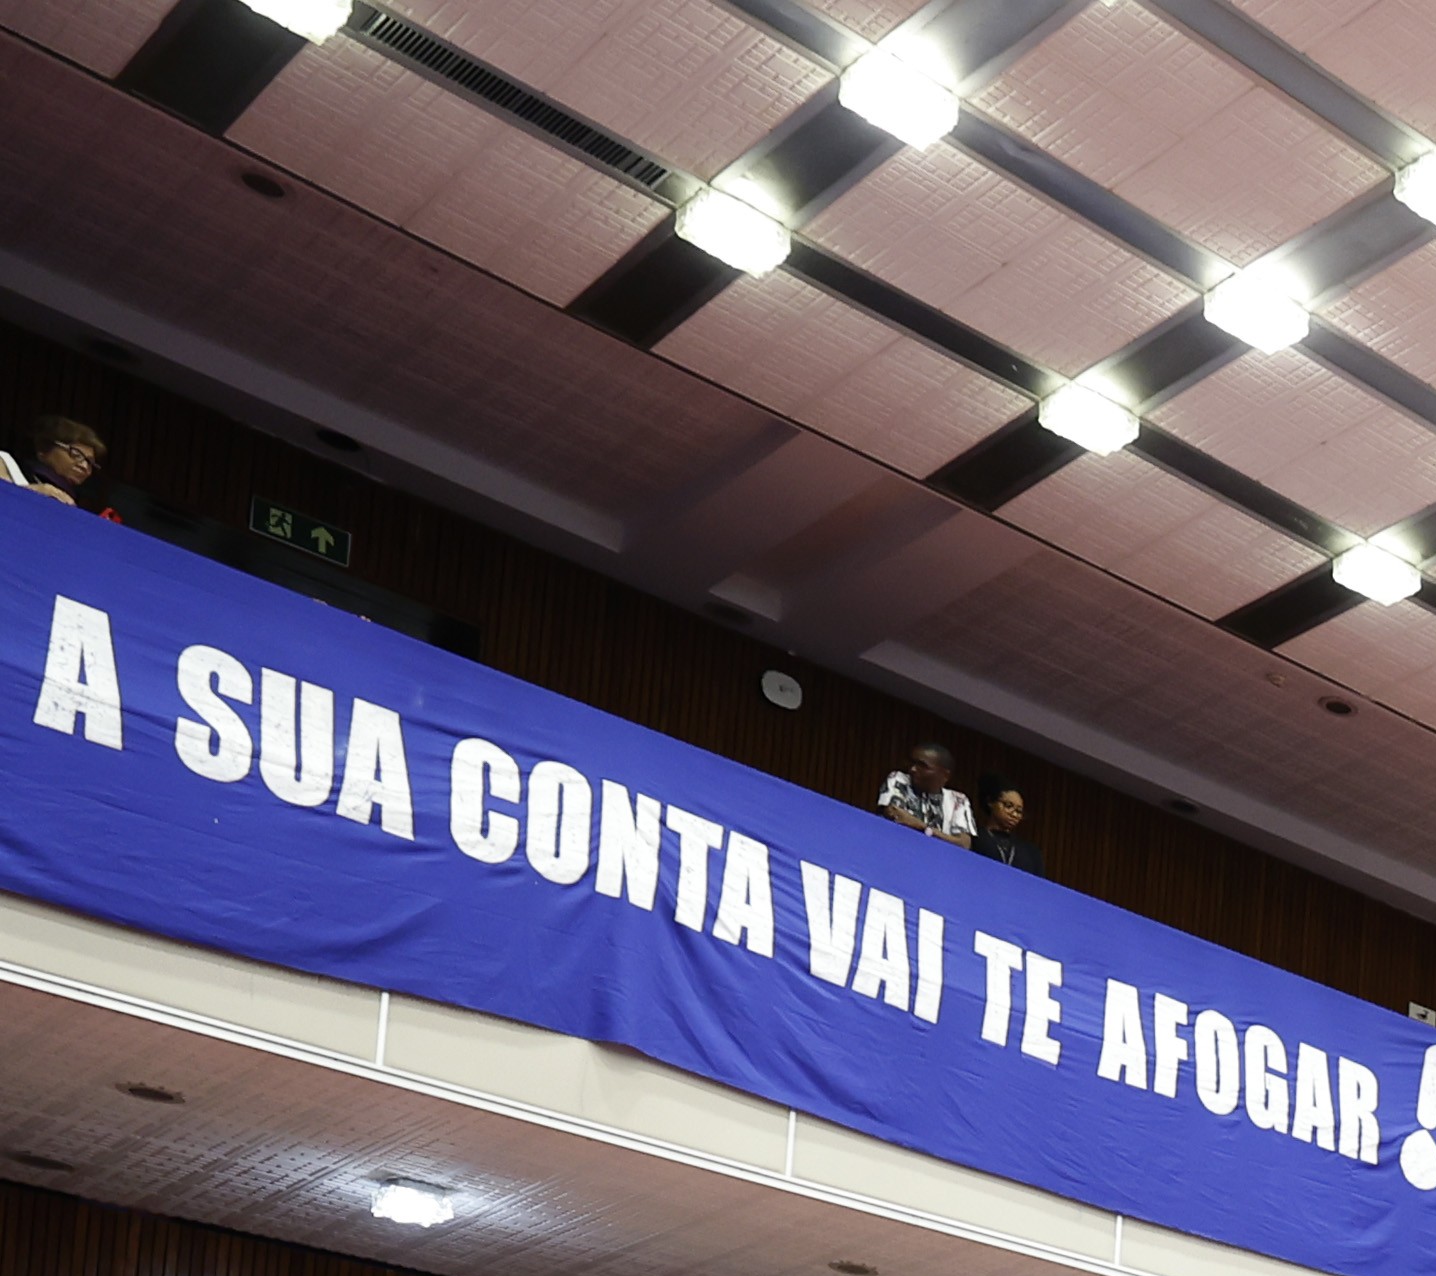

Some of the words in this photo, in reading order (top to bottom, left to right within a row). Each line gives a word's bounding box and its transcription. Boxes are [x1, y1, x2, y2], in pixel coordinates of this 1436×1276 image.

[34, 595, 122, 751] A
[174, 644, 414, 841] SUA
[450, 737, 775, 959] CONTA
[799, 860, 944, 1024] VAI
[974, 930, 1062, 1065] TE
